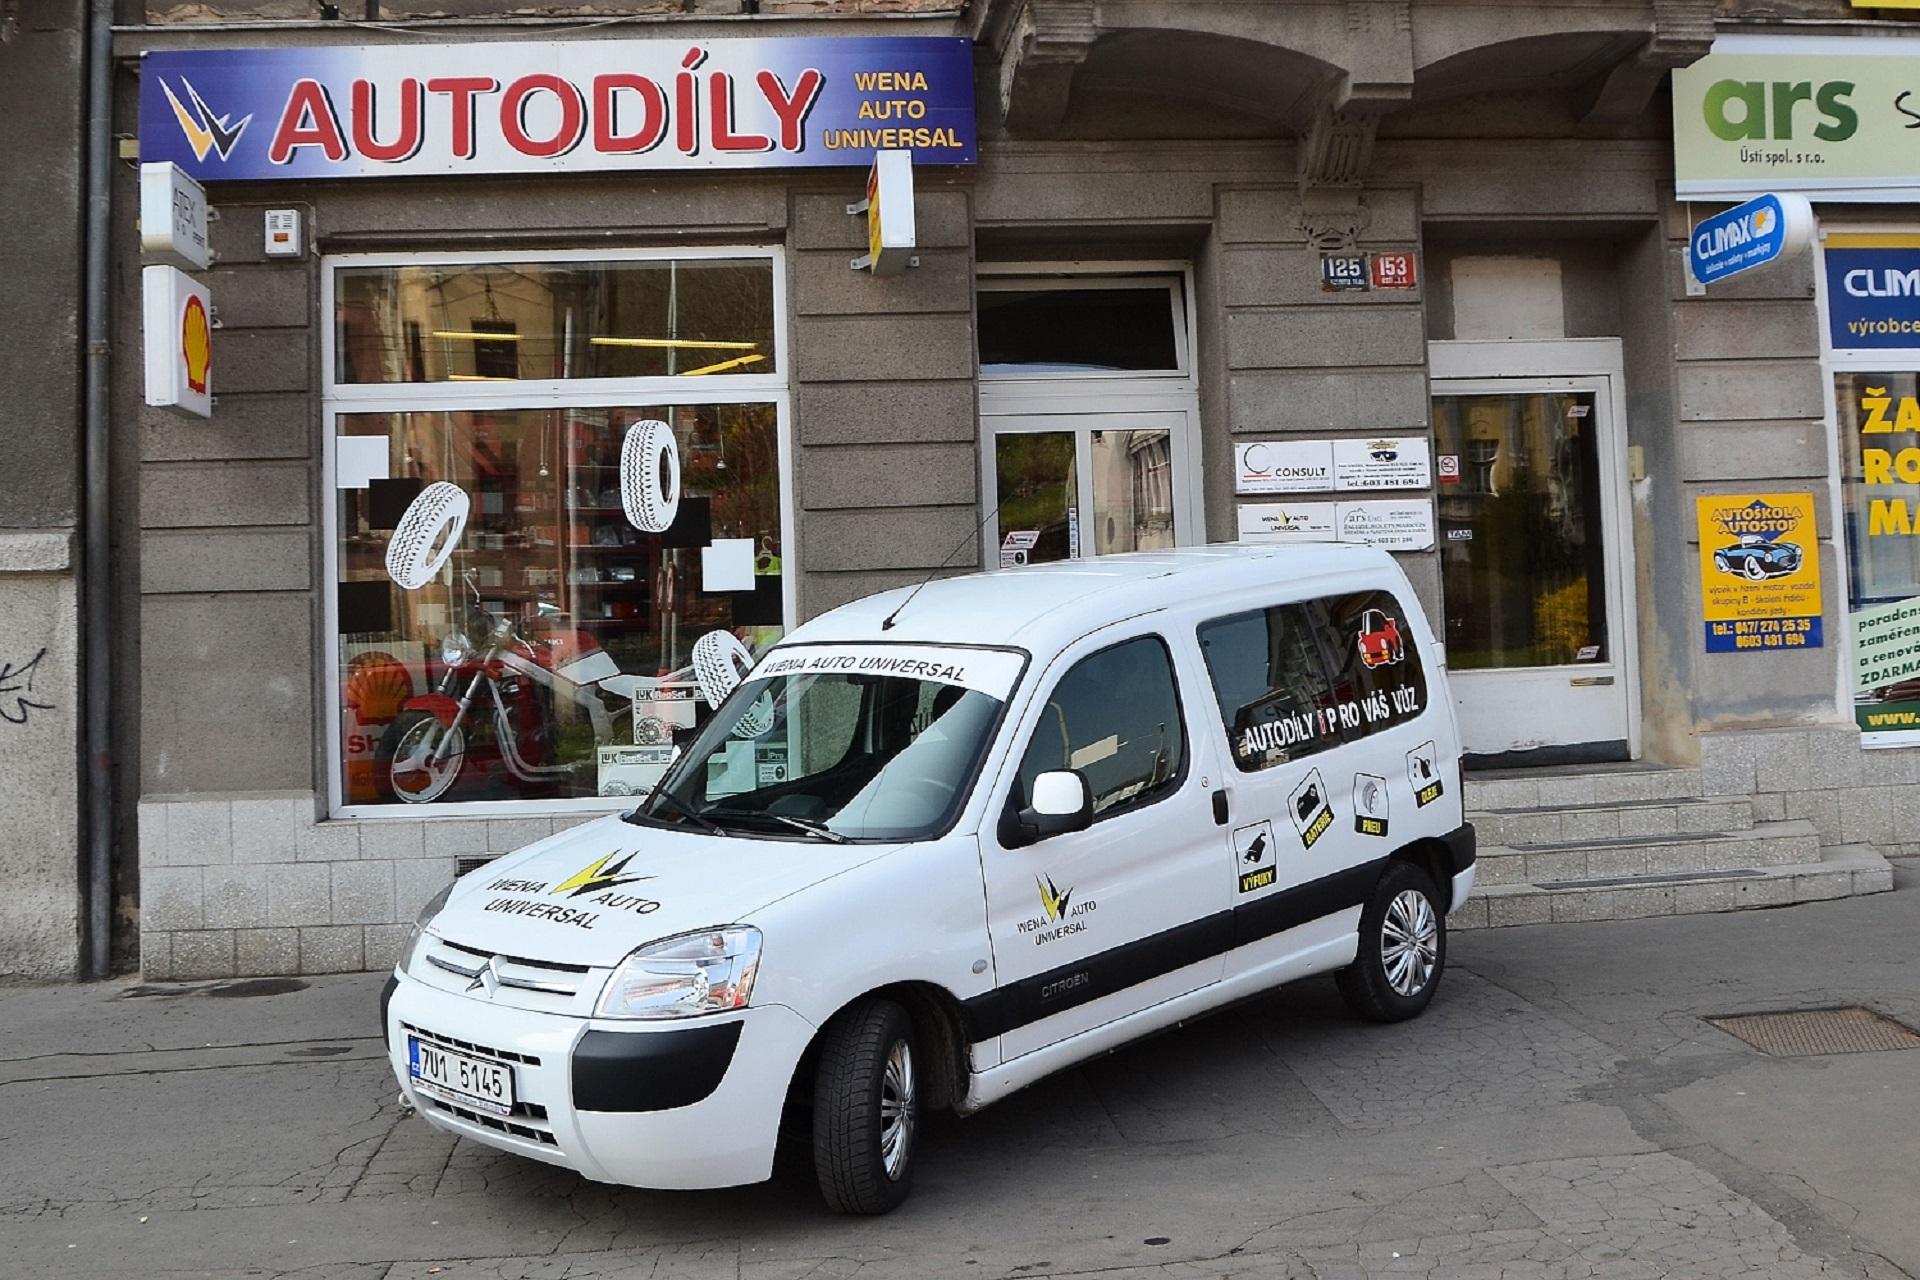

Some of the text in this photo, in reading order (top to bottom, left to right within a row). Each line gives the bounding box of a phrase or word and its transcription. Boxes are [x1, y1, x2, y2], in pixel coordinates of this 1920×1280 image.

[854, 71, 928, 92] WENA
[268, 46, 828, 166] AUTODÍLY
[858, 99, 925, 120] AUTO
[1703, 79, 1858, 142] ars
[824, 127, 963, 149] UNIVERSAL
[1740, 146, 1825, 166] Ústí spol. s r.o.
[1697, 214, 1751, 260] CLIMAX
[1328, 258, 1361, 277] 125
[1379, 256, 1408, 276] 153
[1847, 317, 1920, 337] výrobce
[1274, 467, 1326, 477] CONSULT
[1711, 505, 1804, 522] AUTOŠKOLA
[1869, 499, 1920, 537] M
[1718, 519, 1798, 535] AUTOSTOP
[1713, 622, 1733, 635] tel.:
[1760, 620, 1780, 633] 274
[1782, 619, 1796, 632] 25
[1797, 619, 1811, 631] 35
[1764, 634, 1782, 646] 481
[764, 657, 966, 682] WENA AUTO UNIVERSAL
[1860, 658, 1869, 666] a
[1245, 710, 1316, 754] AUTODÍLY
[1326, 701, 1360, 733] PRO
[1361, 689, 1390, 722] VÁŠ
[1391, 684, 1419, 714] VŮZ
[486, 878, 662, 915] WENA AUTO
[484, 898, 600, 930] UNIVERSAL
[1017, 900, 1097, 934] WENA AUTO
[1035, 920, 1087, 946] UNIVERSAL
[421, 1047, 448, 1083] 7U1
[460, 1060, 502, 1098] 5145
